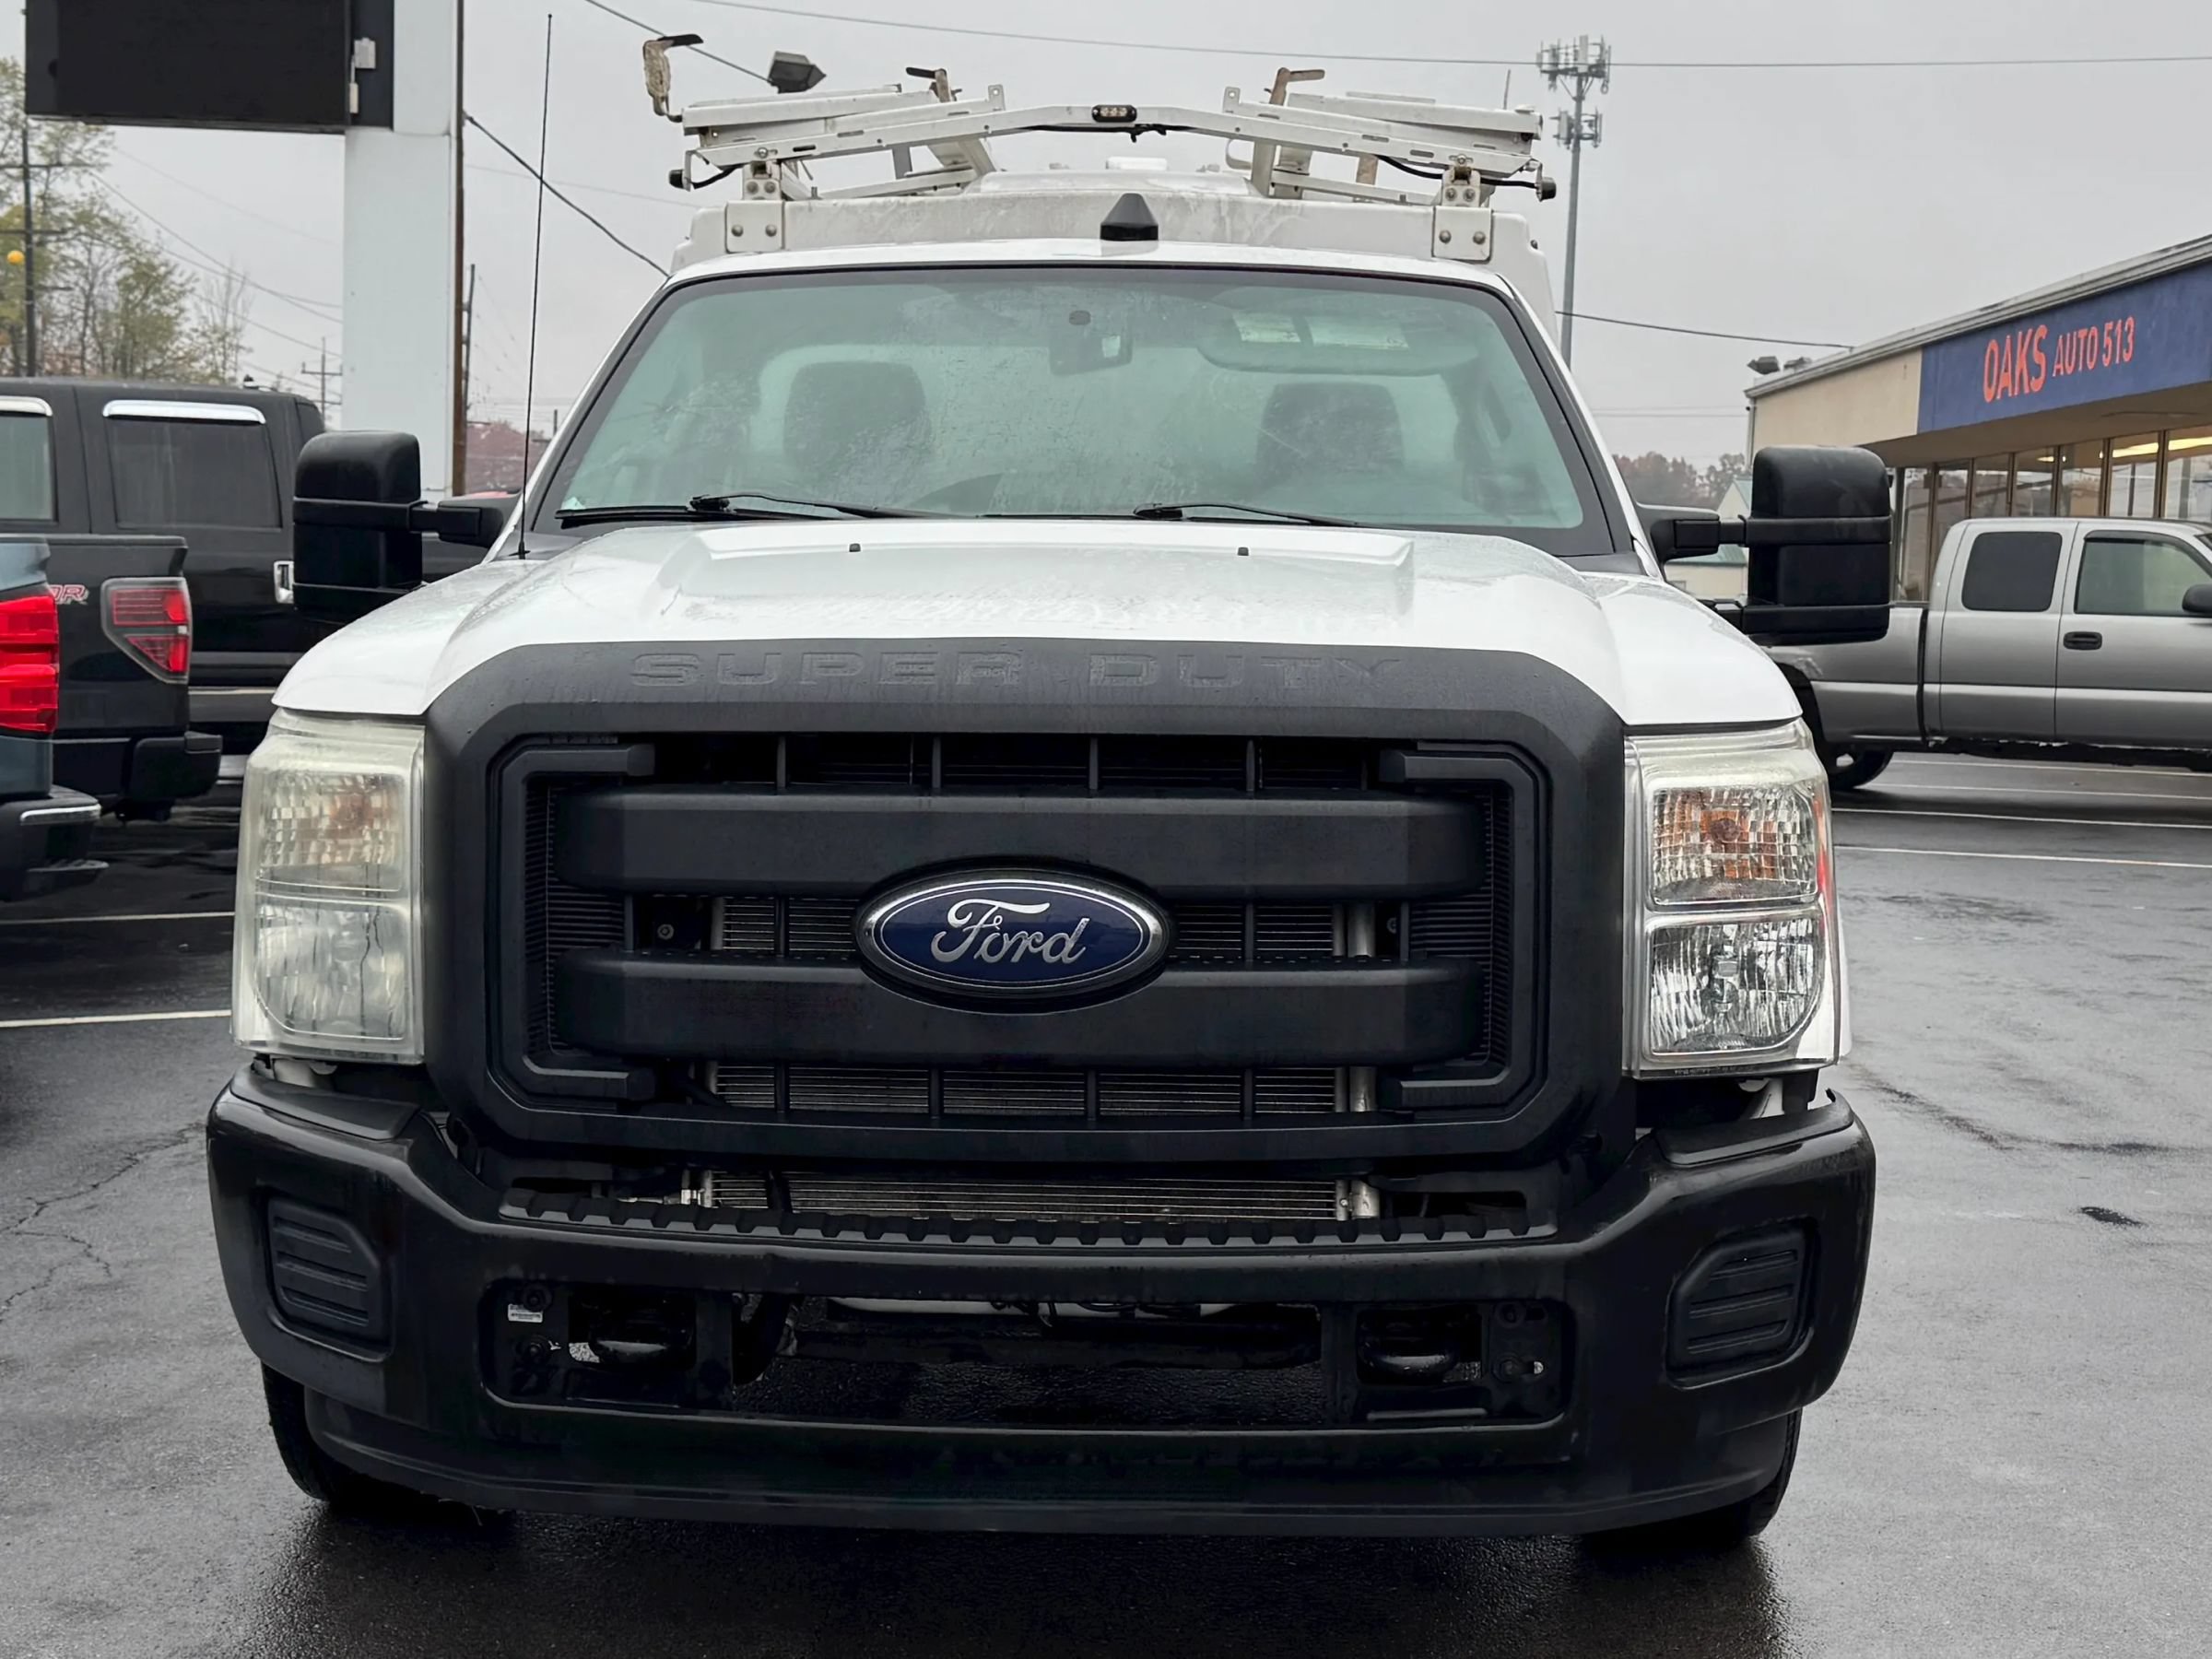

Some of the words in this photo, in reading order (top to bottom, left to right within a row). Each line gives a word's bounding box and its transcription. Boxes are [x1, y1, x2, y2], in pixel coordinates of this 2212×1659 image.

[1983, 324, 2048, 403] OAKS
[2053, 326, 2100, 377] AUTO
[2102, 316, 2136, 367] 513
[630, 652, 1024, 687] SUPER
[1089, 653, 1400, 689] DUTY
[931, 899, 1090, 964] Ford
